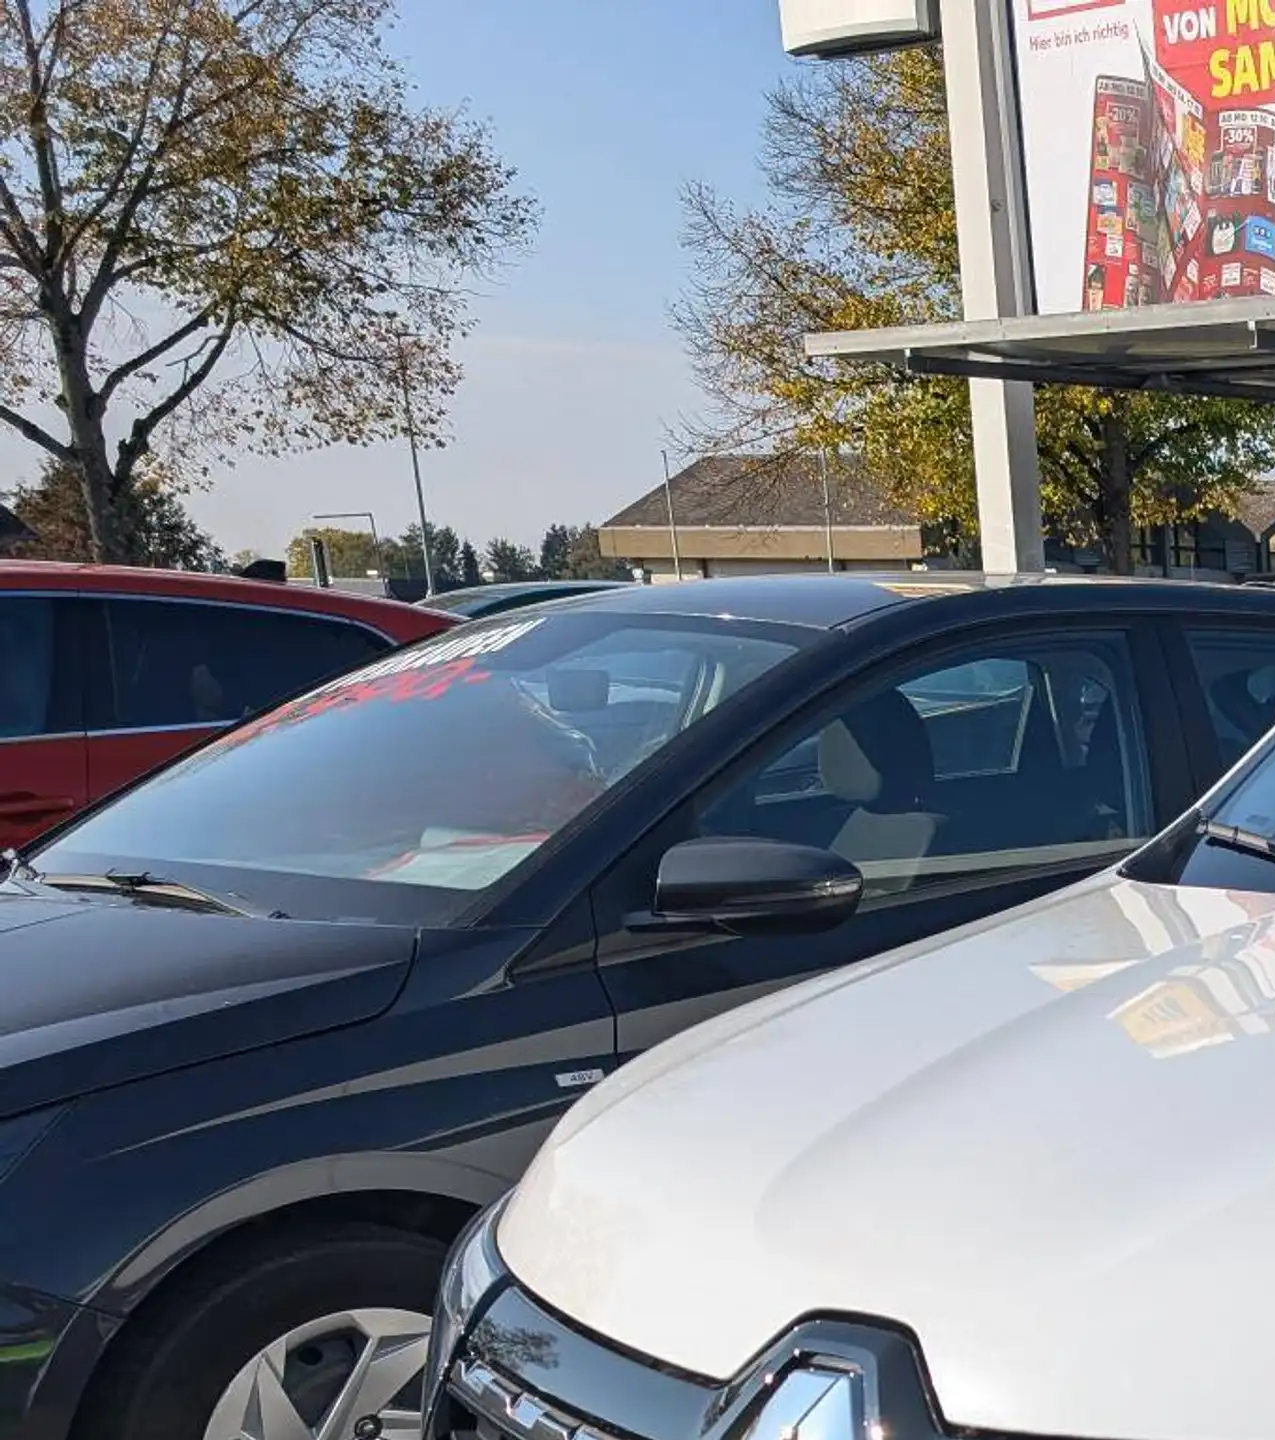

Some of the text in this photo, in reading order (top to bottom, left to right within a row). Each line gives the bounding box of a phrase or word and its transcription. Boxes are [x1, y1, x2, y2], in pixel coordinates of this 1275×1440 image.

[1029, 21, 1130, 51] Hier bin ich richtig
[1164, 7, 1216, 44] VON
[1224, 128, 1254, 143] -30%
